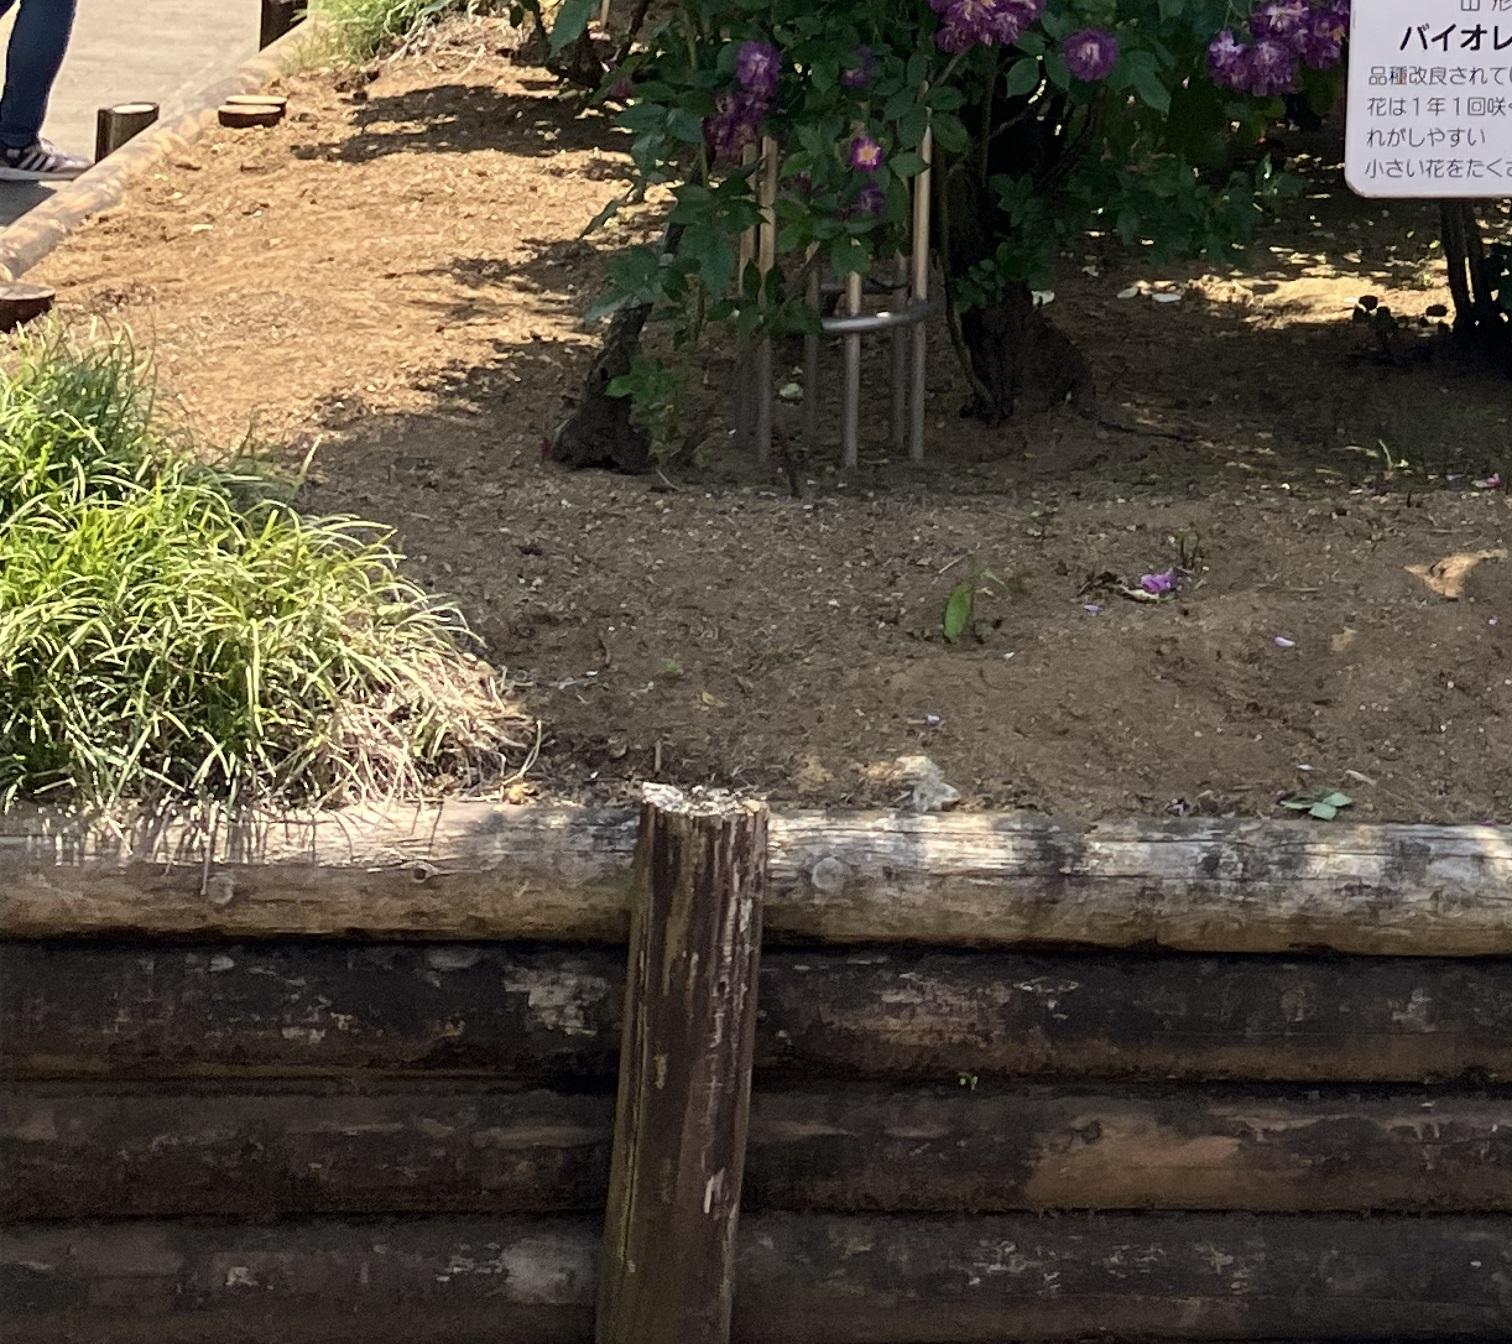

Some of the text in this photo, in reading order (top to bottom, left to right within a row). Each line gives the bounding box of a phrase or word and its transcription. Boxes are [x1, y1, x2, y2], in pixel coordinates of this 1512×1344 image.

[1366, 127, 1486, 148] れがしやすい
